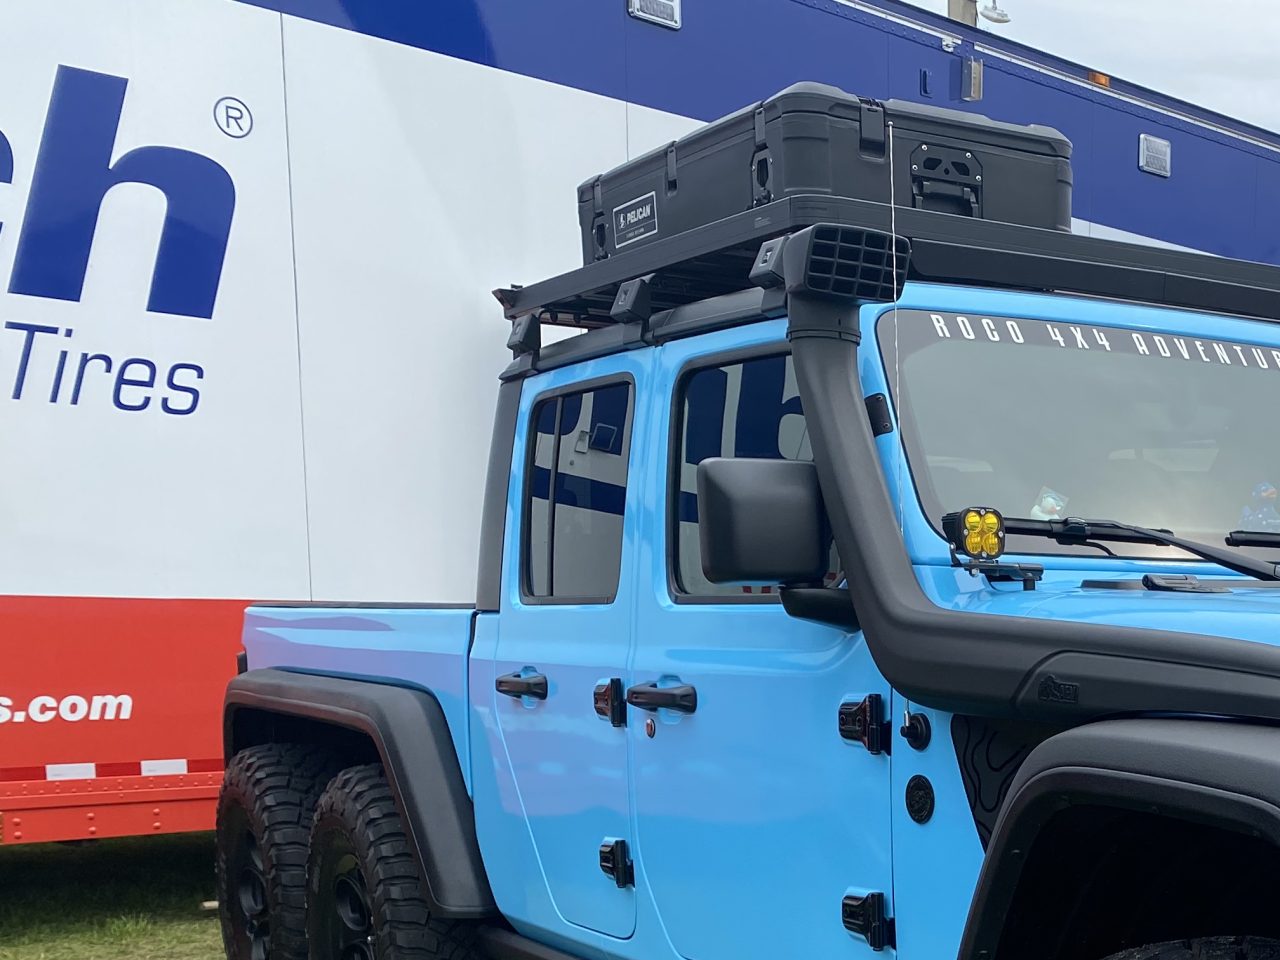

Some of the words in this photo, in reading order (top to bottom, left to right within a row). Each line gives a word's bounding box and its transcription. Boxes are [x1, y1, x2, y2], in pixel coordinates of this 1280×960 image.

[626, 203, 651, 225] PELICAN
[1047, 324, 1111, 351] 4X4
[5, 321, 204, 416] Tires
